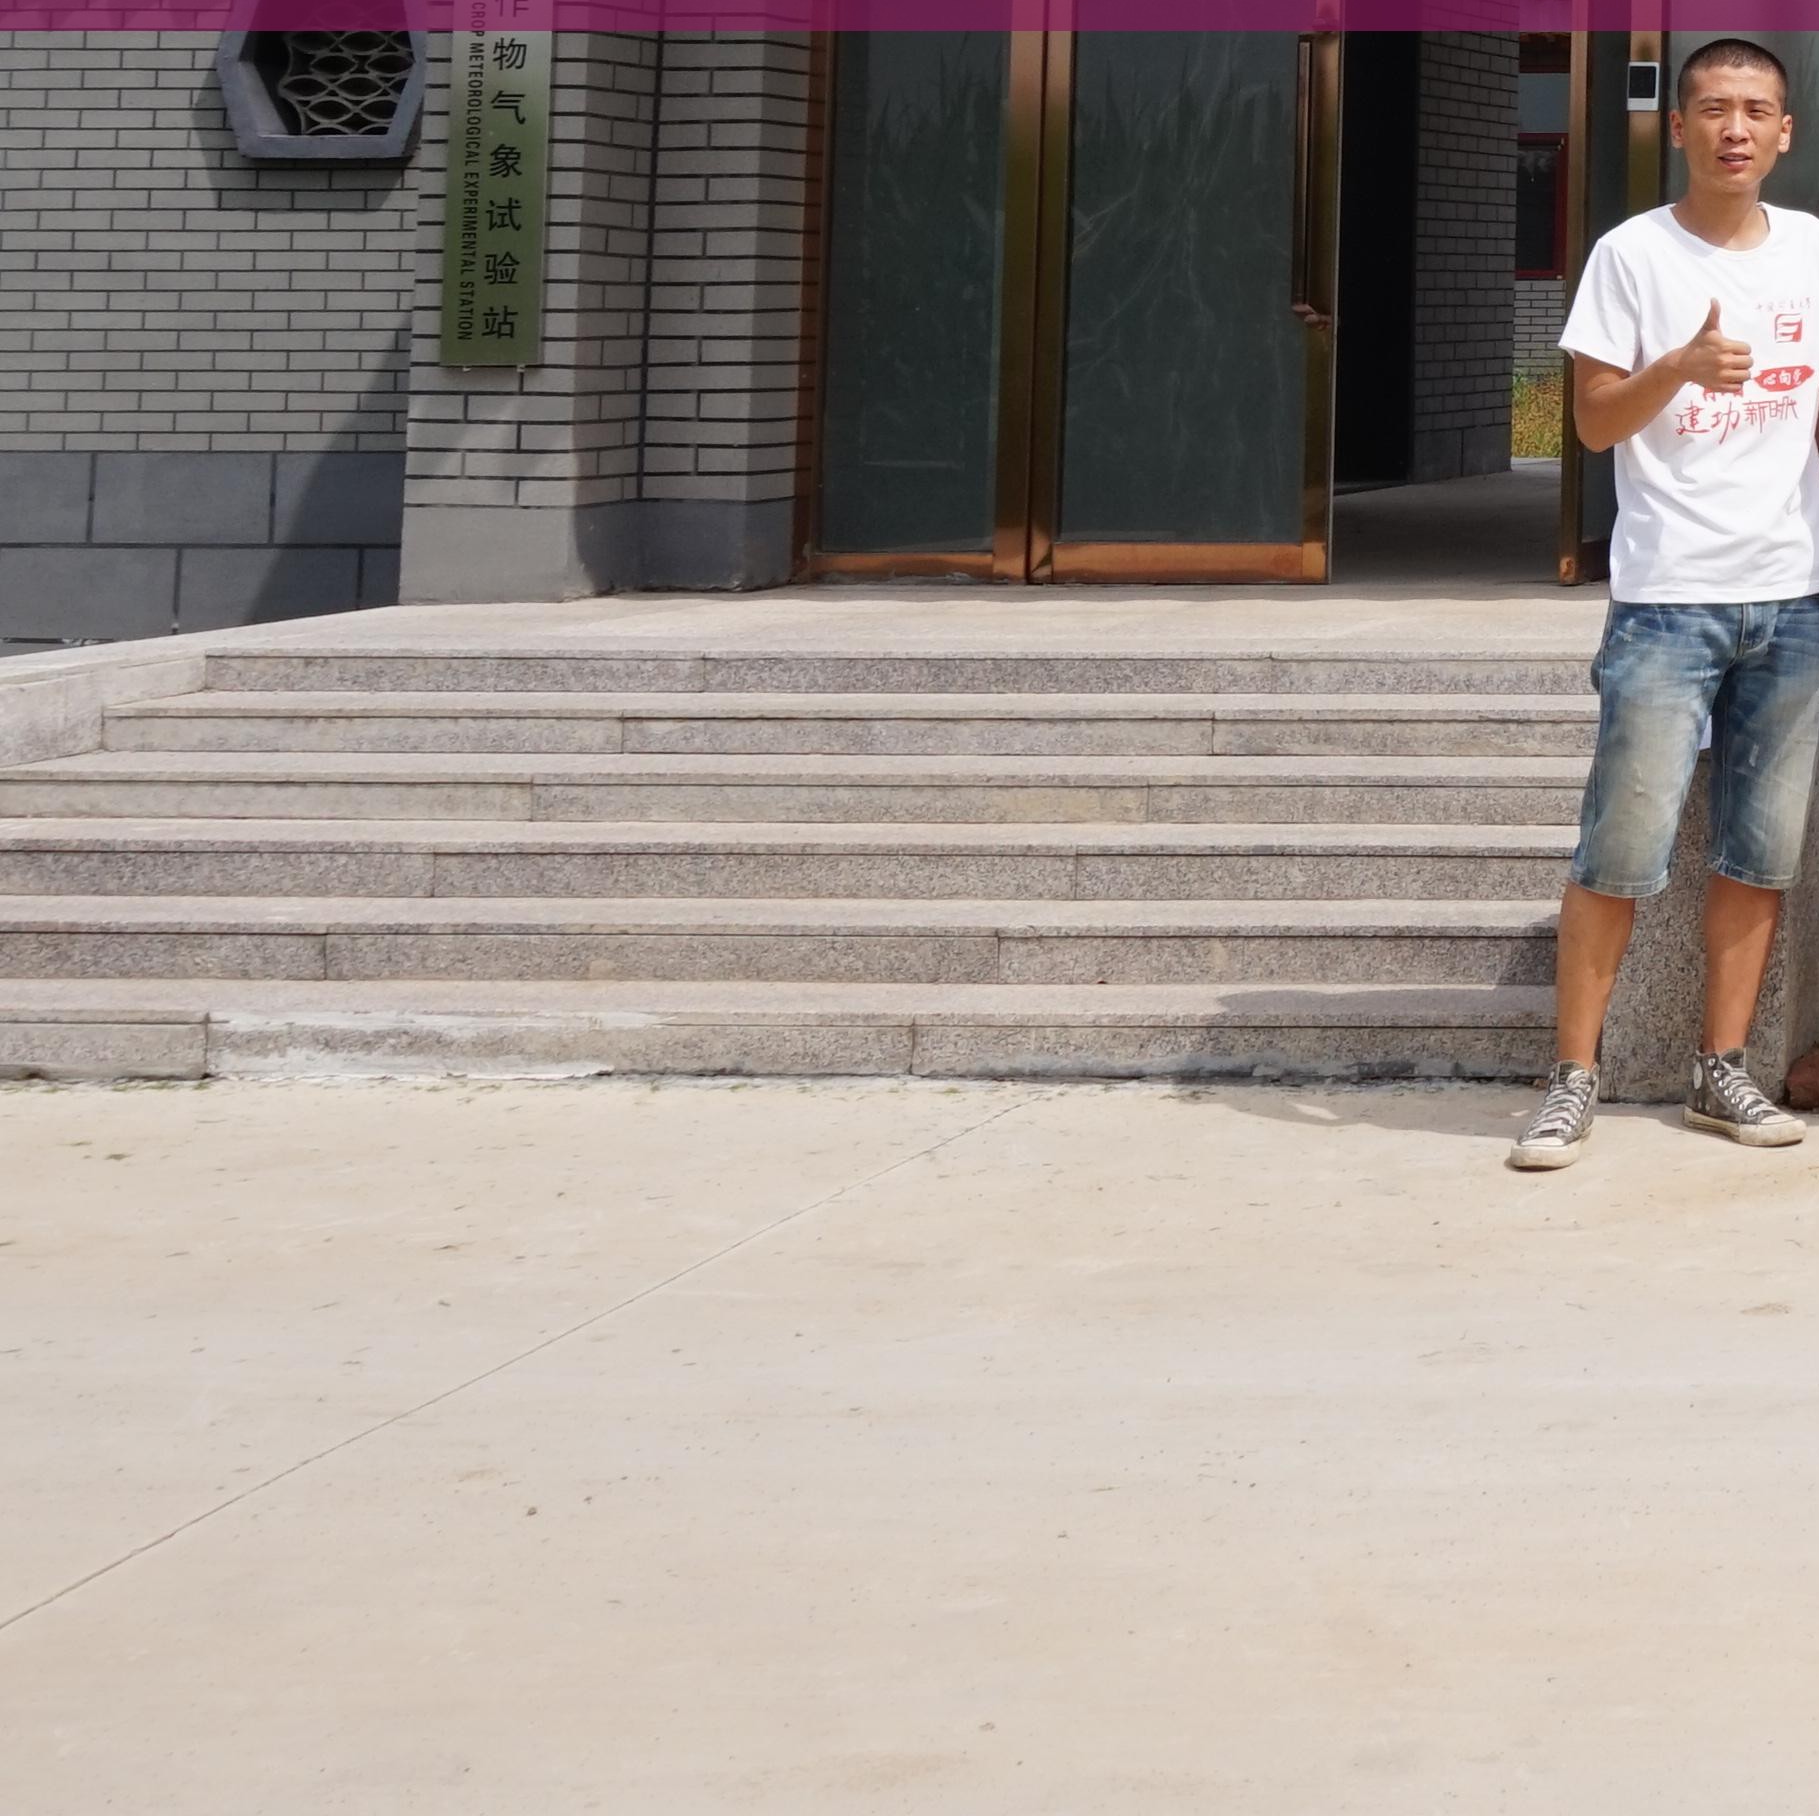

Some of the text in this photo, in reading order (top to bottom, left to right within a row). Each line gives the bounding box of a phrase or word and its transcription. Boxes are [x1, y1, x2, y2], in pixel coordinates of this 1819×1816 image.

[468, 2, 487, 37] CROP
[465, 43, 485, 168] METEOROLOGICAL
[460, 172, 481, 274] EXPERIMENTAL
[457, 280, 475, 341] STATION
